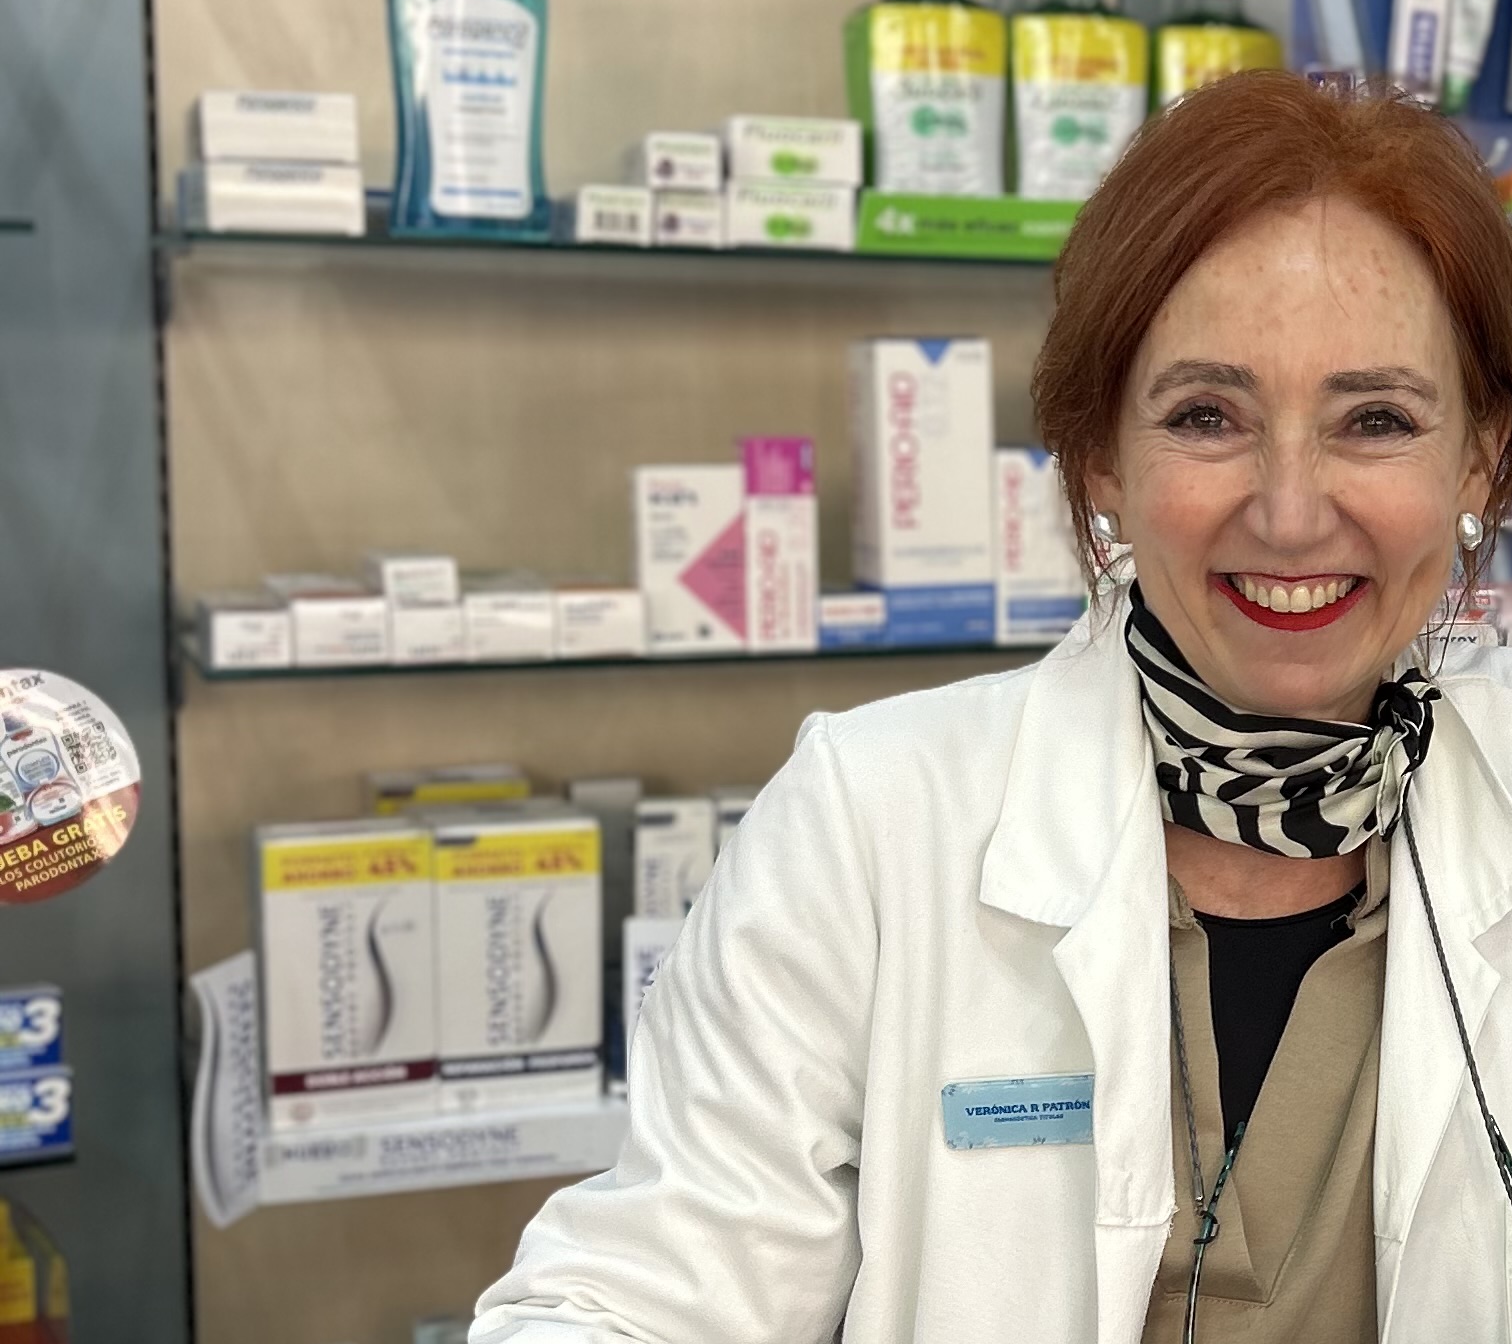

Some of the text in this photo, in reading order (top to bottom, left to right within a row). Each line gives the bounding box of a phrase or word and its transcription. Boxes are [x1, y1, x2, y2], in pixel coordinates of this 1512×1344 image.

[52, 805, 127, 846] GRATIS
[15, 848, 104, 892] PARODONTAX
[319, 904, 343, 1060] SENSODYNE
[485, 895, 511, 1047] SENSODYNE
[20, 998, 61, 1044] 3
[29, 1077, 71, 1123] 3
[965, 1099, 1091, 1117] VERÓNICA R PATRÓN
[379, 1126, 519, 1154] SENSODYNE
